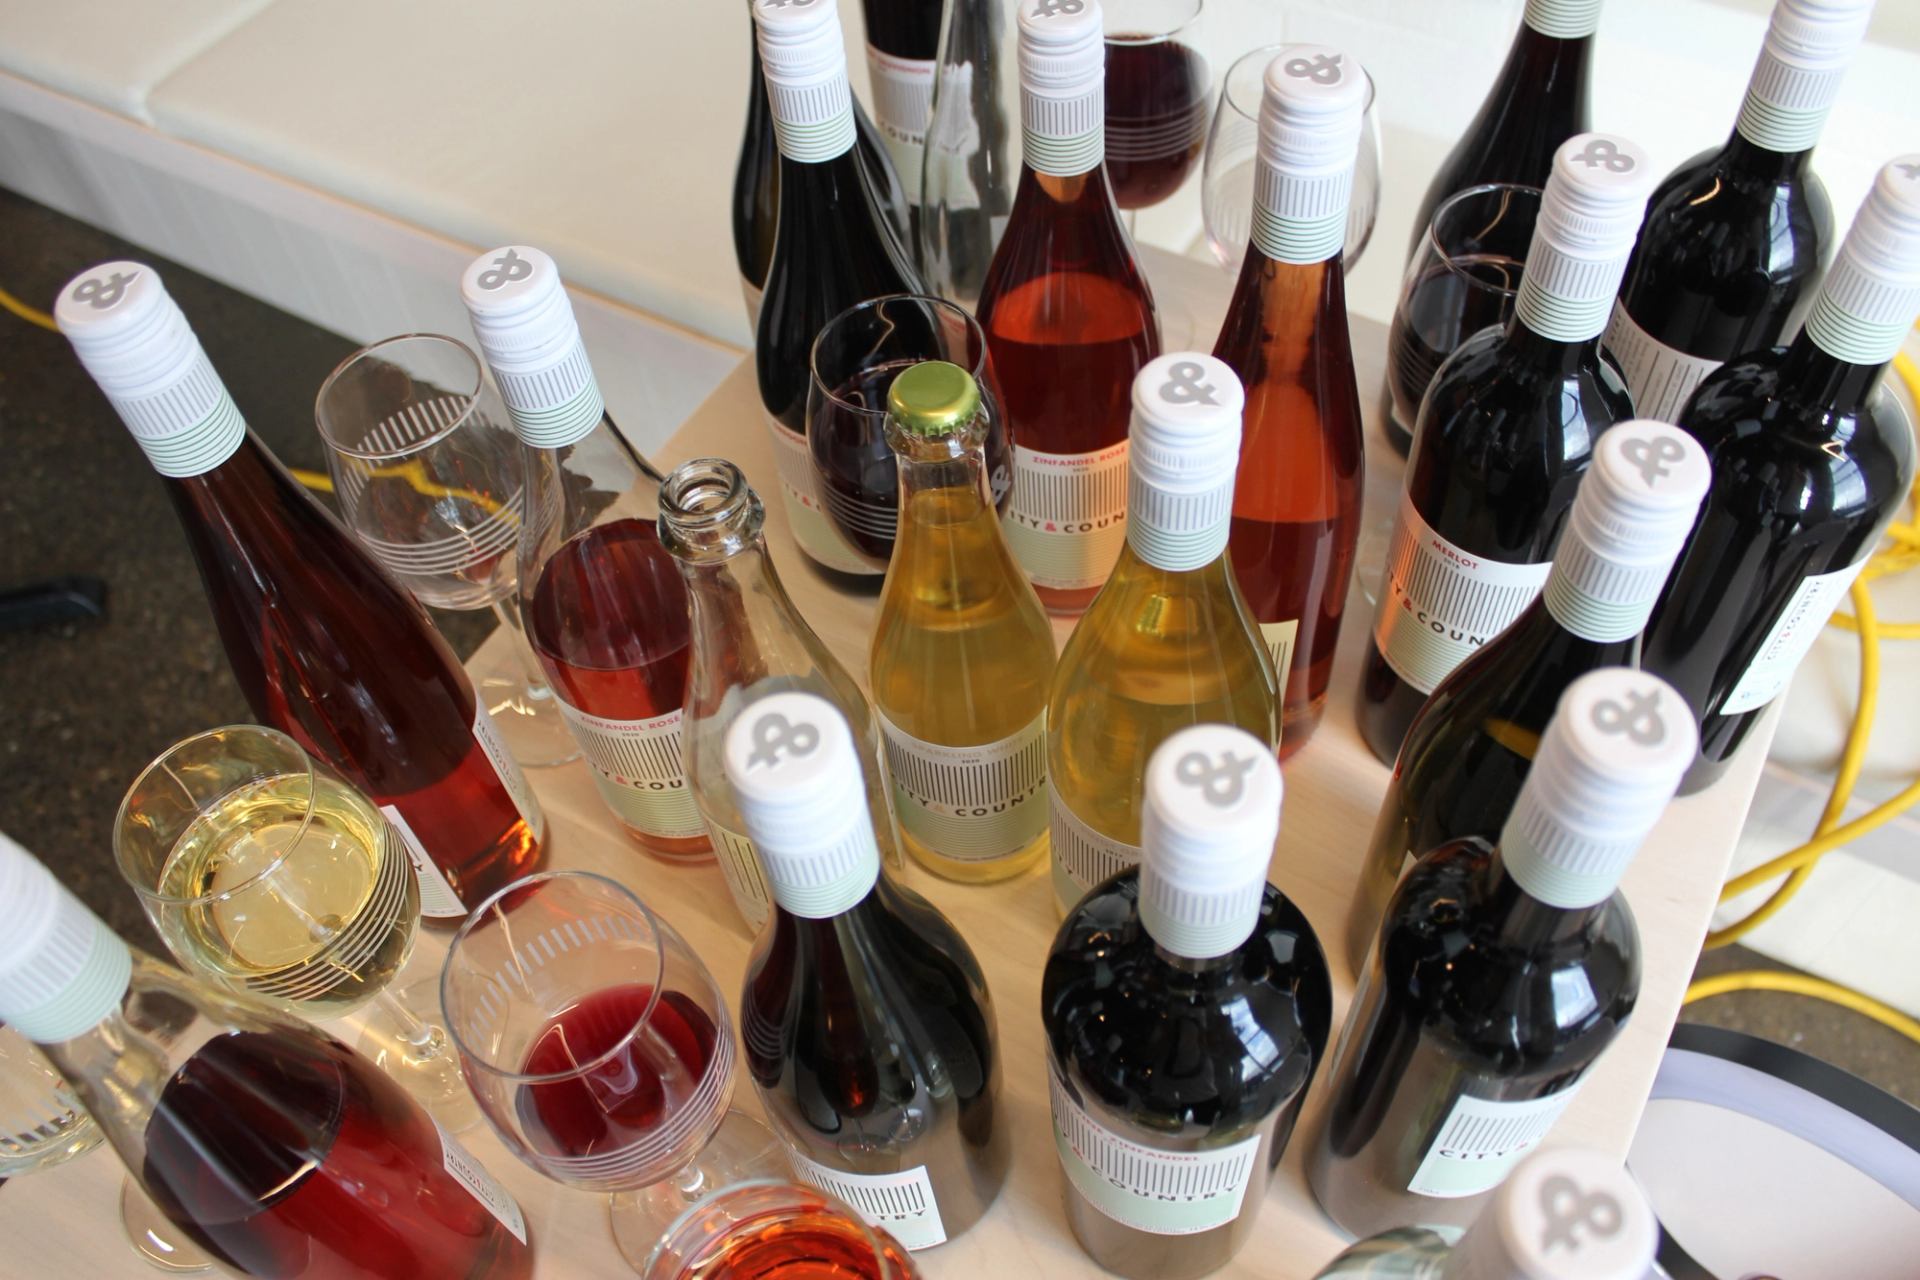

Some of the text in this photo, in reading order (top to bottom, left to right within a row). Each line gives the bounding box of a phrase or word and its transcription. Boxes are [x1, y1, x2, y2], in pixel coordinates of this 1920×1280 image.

[1284, 55, 1341, 84] &
[1571, 140, 1634, 173] &
[477, 249, 532, 290] &
[72, 272, 141, 309] &
[1159, 361, 1221, 406] &
[1032, 456, 1096, 467] ZINFANDEL
[1620, 437, 1686, 488] &
[1432, 539, 1479, 569] MERLOT
[580, 715, 645, 732] ZINFANDEL
[1590, 689, 1667, 748] &
[747, 714, 821, 769] &
[1175, 751, 1256, 808] &
[1538, 1174, 1624, 1257] &
